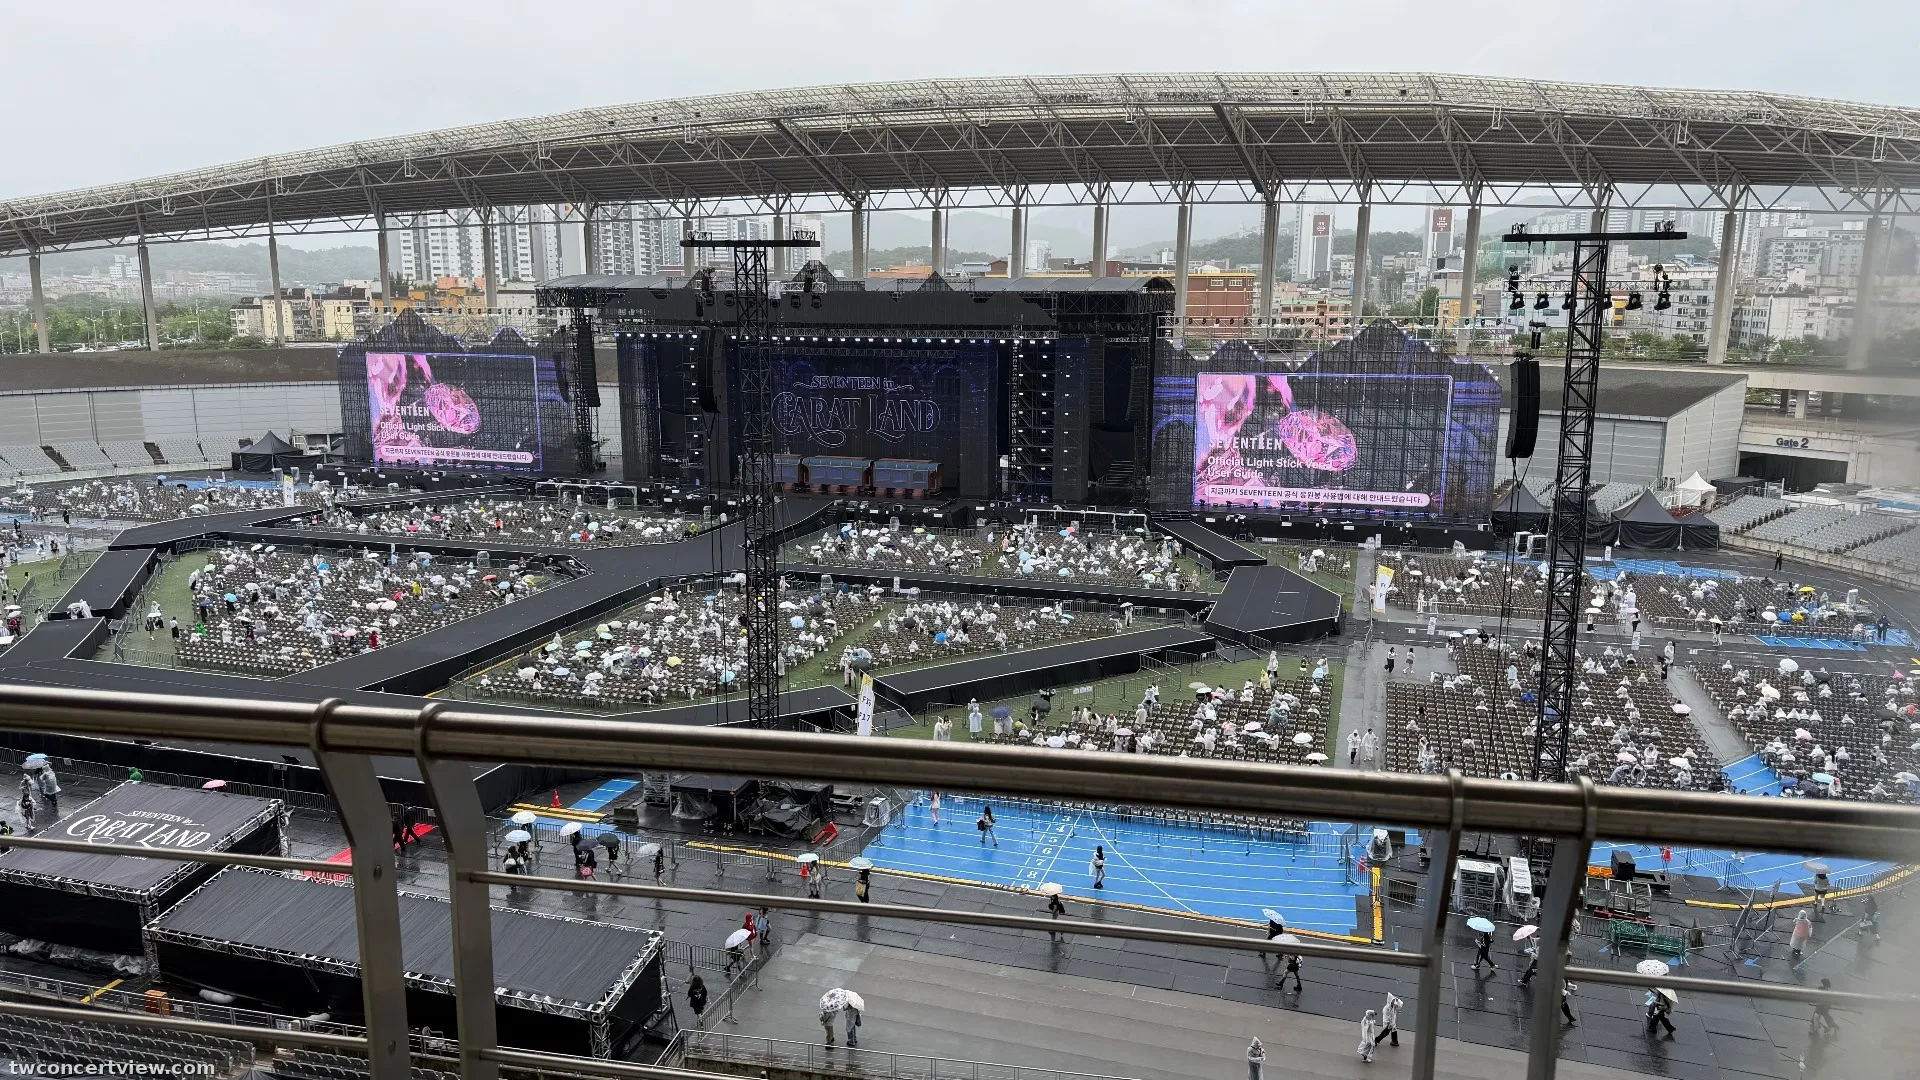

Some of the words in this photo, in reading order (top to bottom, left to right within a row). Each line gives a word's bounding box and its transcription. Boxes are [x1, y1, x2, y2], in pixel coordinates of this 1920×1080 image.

[811, 375, 880, 390] SEVENTEEN
[883, 377, 895, 390] in
[380, 405, 429, 416] SEVENTEEN
[771, 391, 862, 448] CARAT
[866, 393, 941, 443] LAND
[380, 421, 406, 431] Official
[407, 422, 425, 432] Light
[426, 423, 445, 432] Stick
[381, 431, 397, 440] User
[399, 432, 420, 441] Guide
[1776, 437, 1799, 448] Gate
[1801, 437, 1809, 448] 2
[1209, 436, 1282, 450] SEVENTEEN
[404, 448, 435, 456] SEVENTEEN
[1207, 456, 1245, 467] Official
[1246, 457, 1274, 469] Light
[1275, 458, 1303, 469] Stick
[1207, 467, 1232, 478] User
[1233, 468, 1264, 480] Guide
[1210, 487, 1238, 496] 지금까지
[1239, 488, 1283, 498] SEVENTEEN
[1284, 490, 1298, 499] 공식
[1352, 493, 1367, 502] 대해
[128, 810, 184, 823] SEVENTEEN
[66, 814, 153, 845] CARAT
[135, 822, 211, 849] LAND
